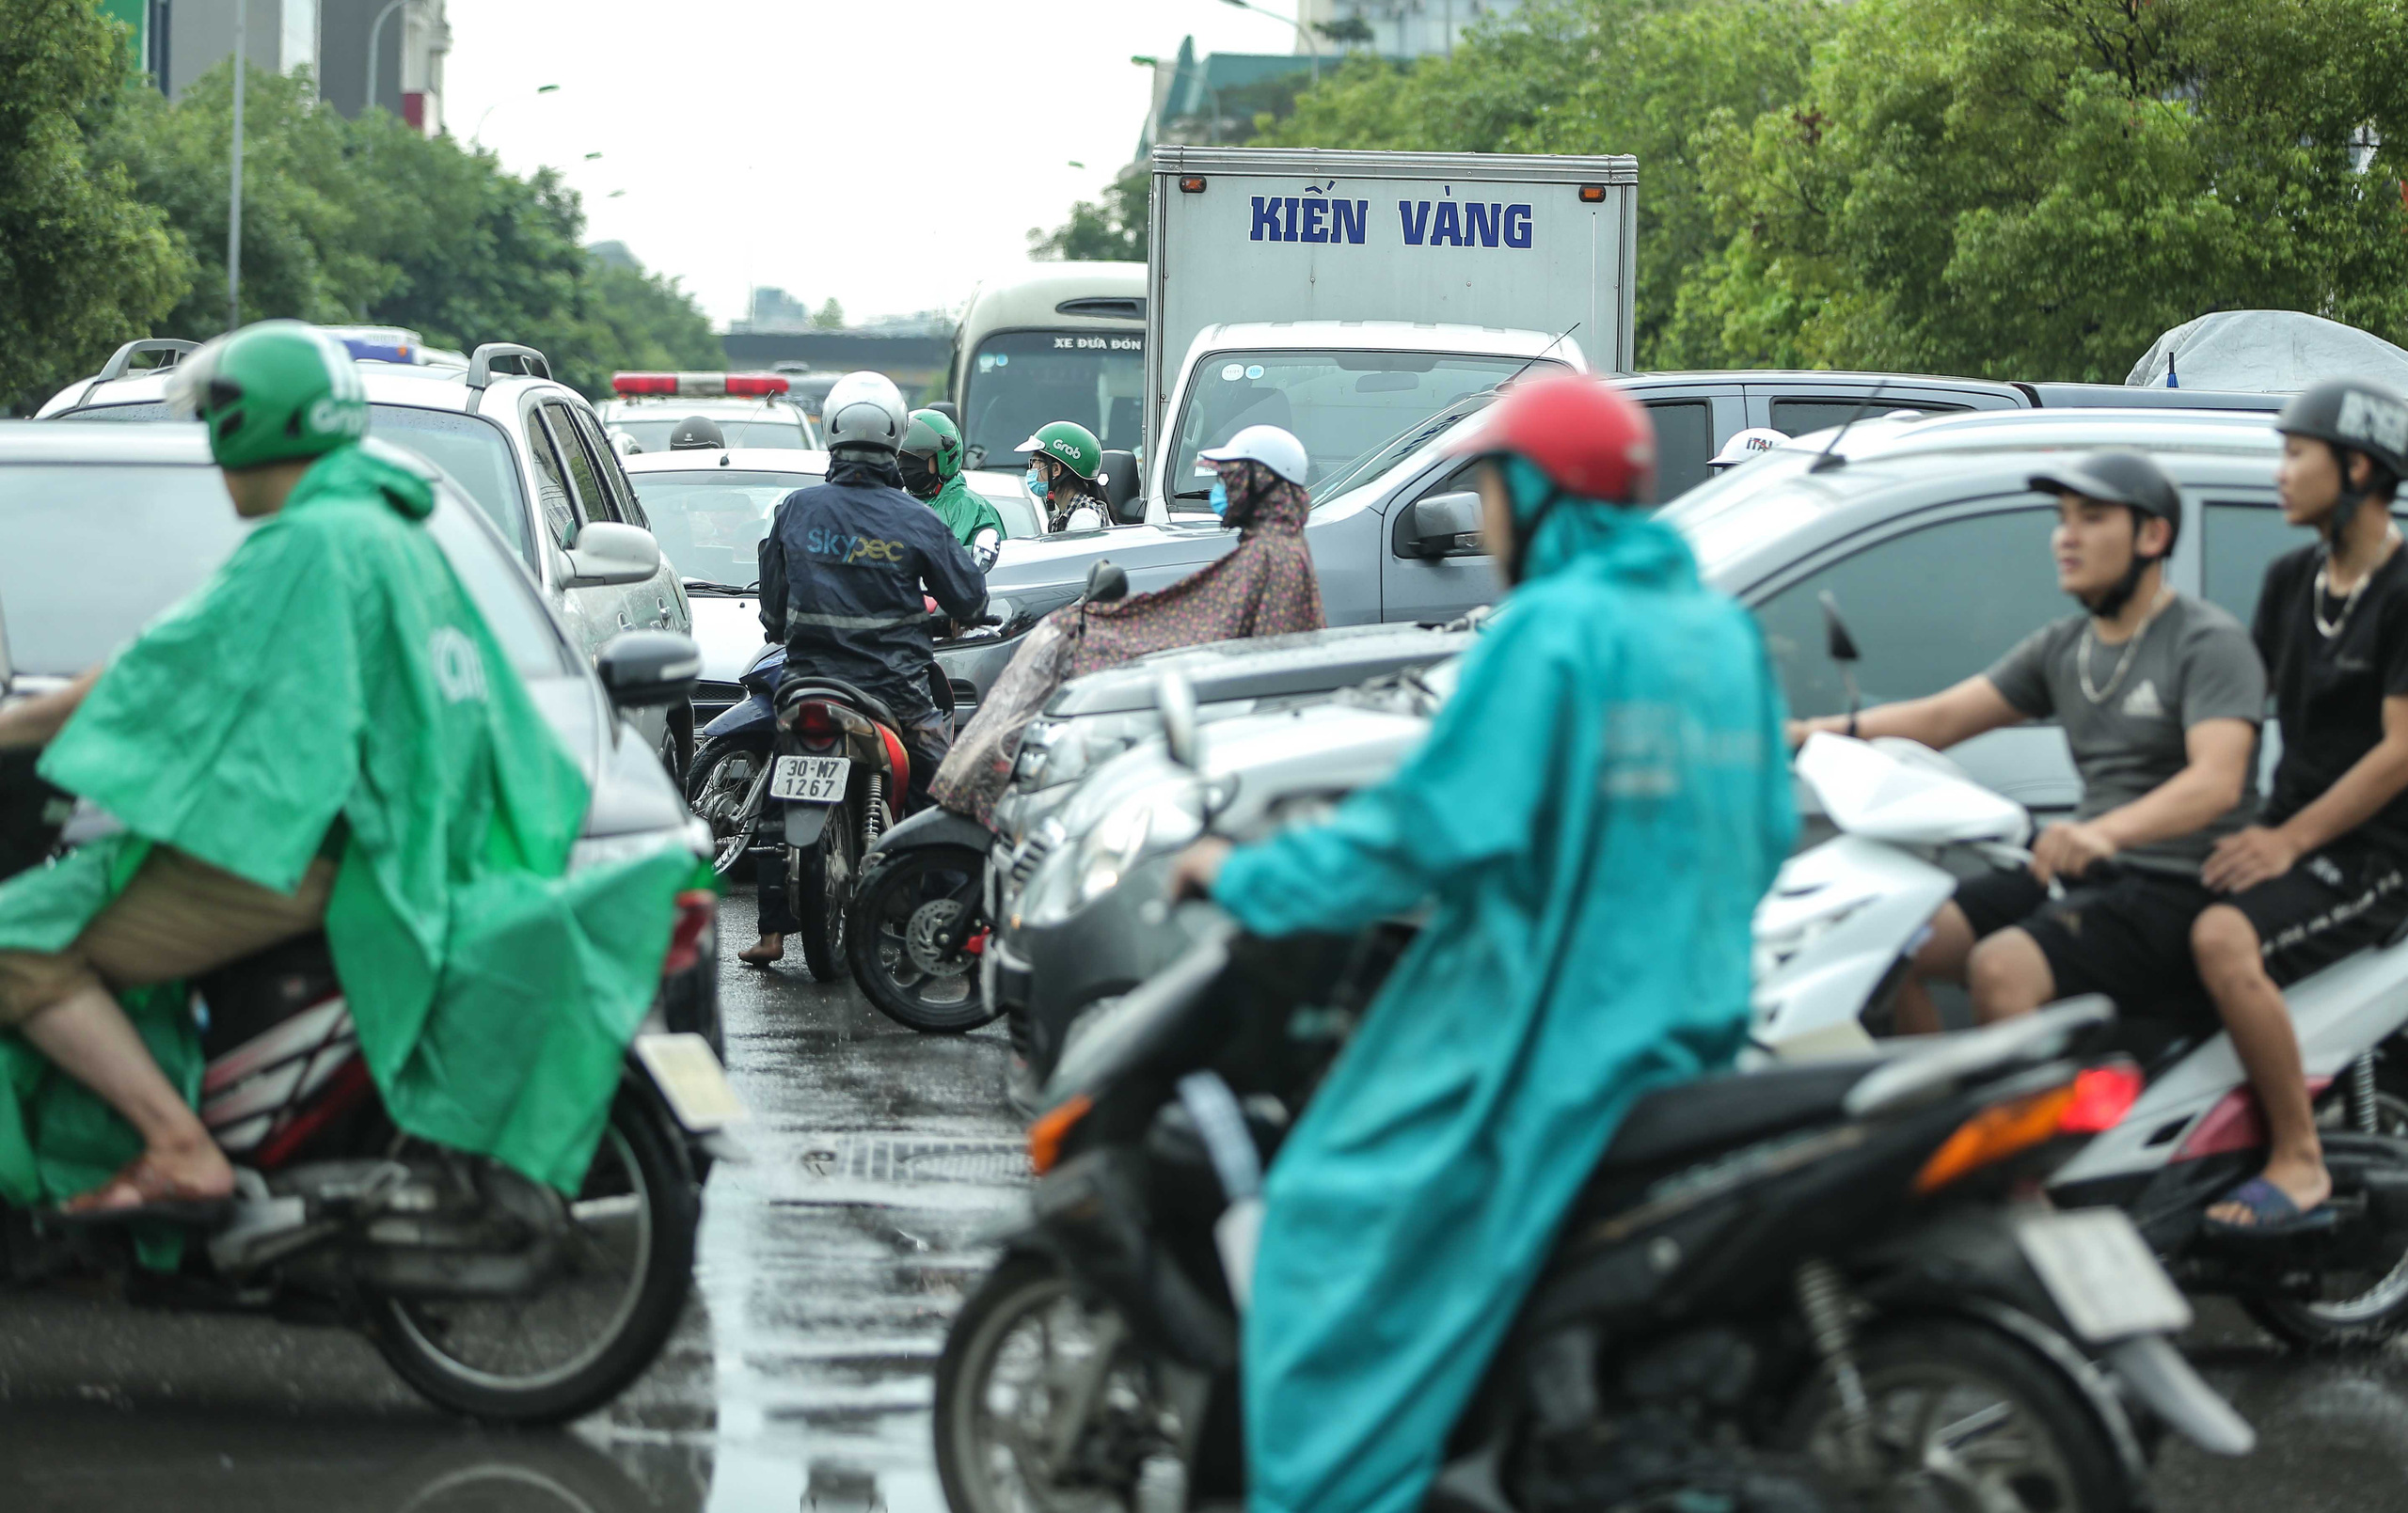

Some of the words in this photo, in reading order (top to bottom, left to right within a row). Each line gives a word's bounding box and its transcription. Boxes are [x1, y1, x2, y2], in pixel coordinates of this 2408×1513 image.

[1249, 180, 1370, 244] KIẾN
[1397, 184, 1533, 249] VÀNG
[1054, 337, 1073, 349] XE
[1053, 438, 1082, 460] Grab
[786, 778, 835, 797] 1267
